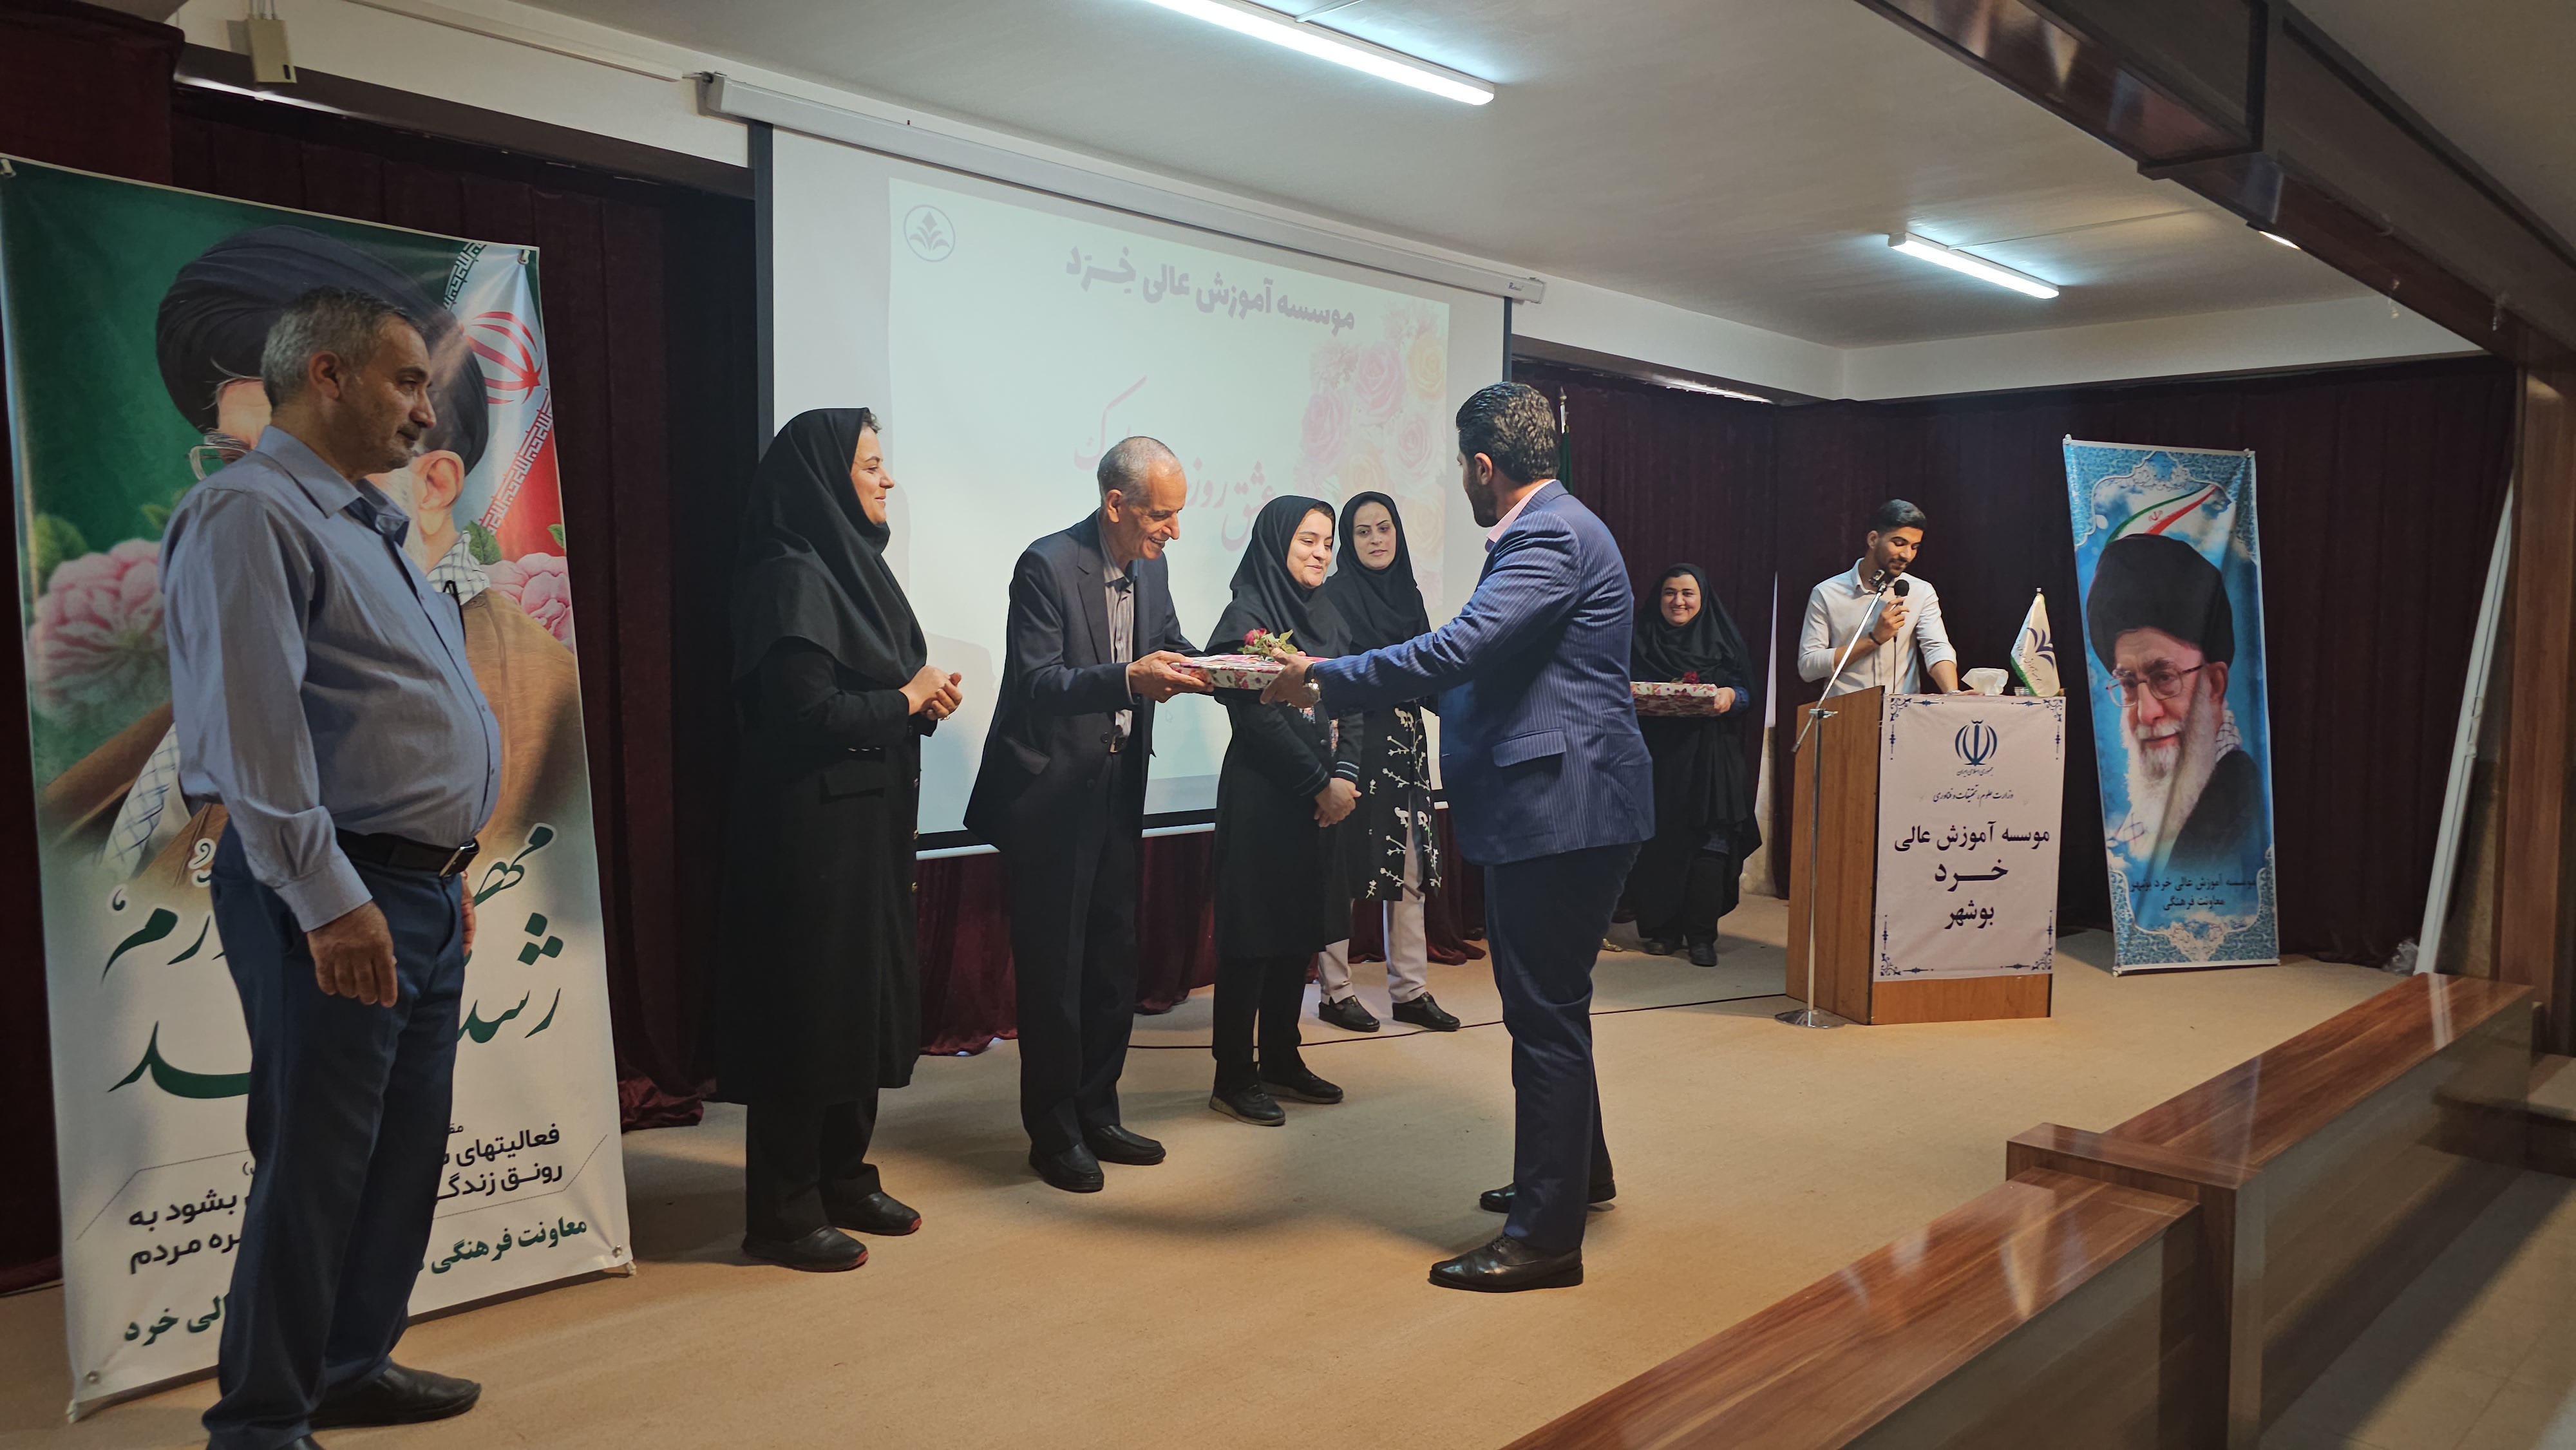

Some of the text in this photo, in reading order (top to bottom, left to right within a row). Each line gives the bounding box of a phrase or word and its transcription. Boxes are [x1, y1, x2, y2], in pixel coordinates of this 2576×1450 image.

[1142, 263, 1190, 304] عالی
[1196, 271, 1273, 320] آموزش
[1277, 294, 1355, 337] موسسه
[1993, 789, 2014, 799] وزارت
[1895, 821, 2050, 852] موسسه آموزش عالی
[1935, 858, 2009, 892] خرد
[1944, 899, 1994, 930] بوشهر
[455, 1122, 560, 1167] فعالیتهای
[437, 1162, 563, 1201] رونق زندگ
[128, 1210, 159, 1232] به
[165, 1189, 237, 1224] بشود
[130, 1238, 202, 1275] مردم
[431, 1216, 587, 1274] معاونت فرهنگی
[124, 1307, 180, 1347] خرد
